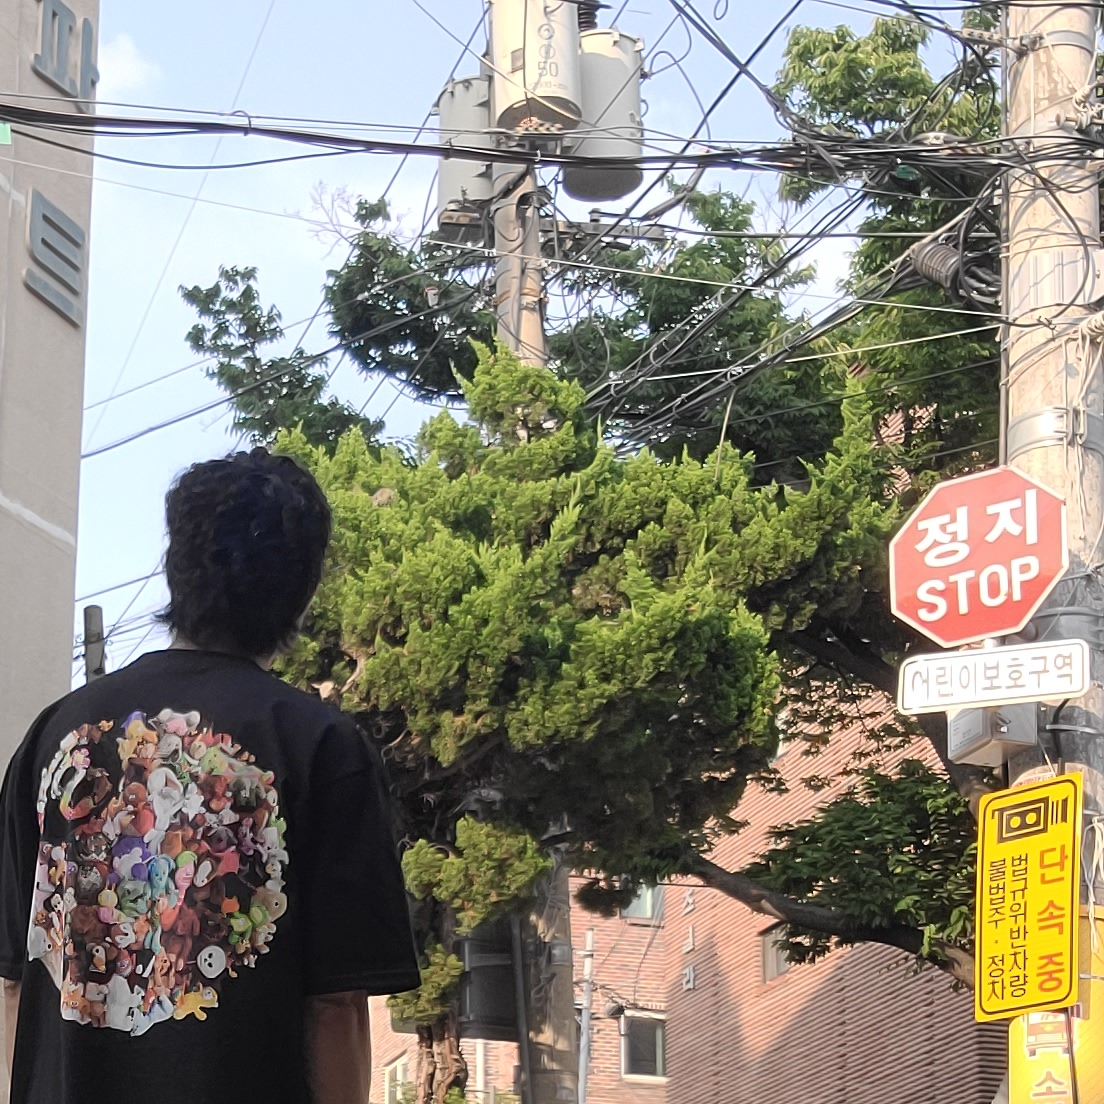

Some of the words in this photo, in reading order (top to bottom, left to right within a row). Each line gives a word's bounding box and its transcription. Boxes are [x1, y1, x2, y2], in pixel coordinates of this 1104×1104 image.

[916, 555, 1040, 622] STOP
[911, 651, 1074, 700] 어린이보호구역
[1009, 854, 1028, 998] 법규위반차량
[1037, 845, 1068, 992] 단속중
